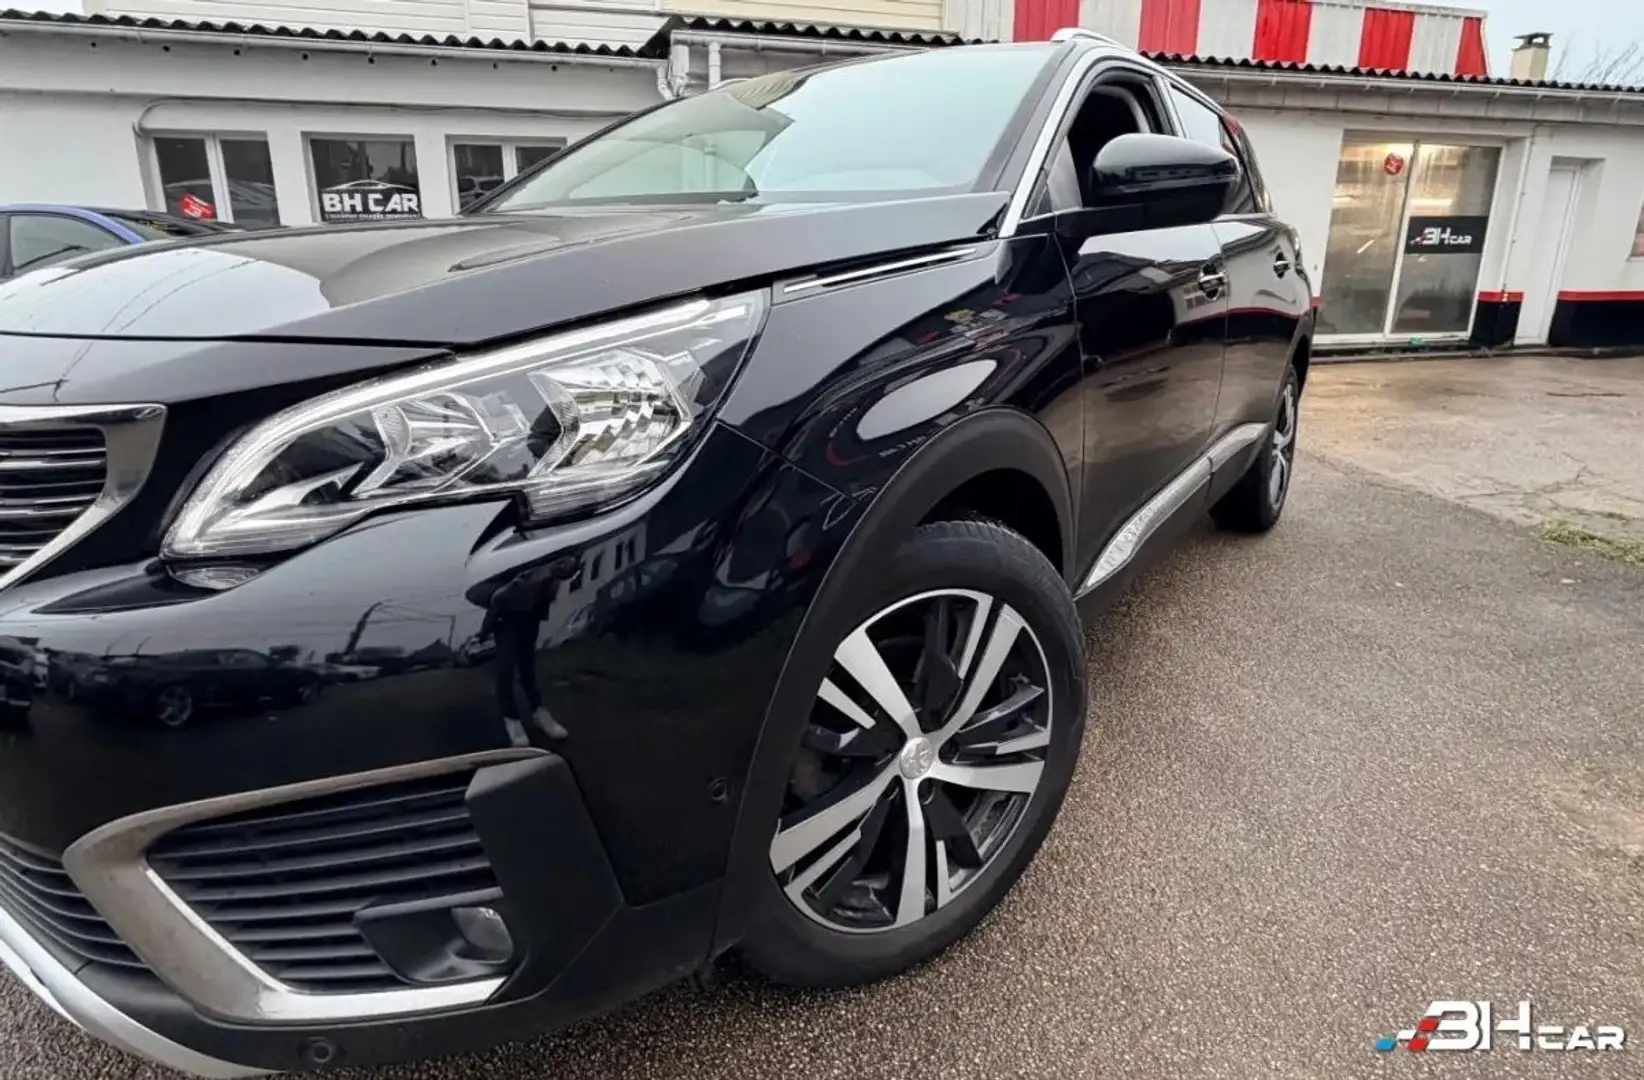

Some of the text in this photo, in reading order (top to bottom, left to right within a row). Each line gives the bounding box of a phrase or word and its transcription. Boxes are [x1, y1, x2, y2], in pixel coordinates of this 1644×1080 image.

[322, 193, 419, 212] BH CAR
[1449, 234, 1473, 245] CAR
